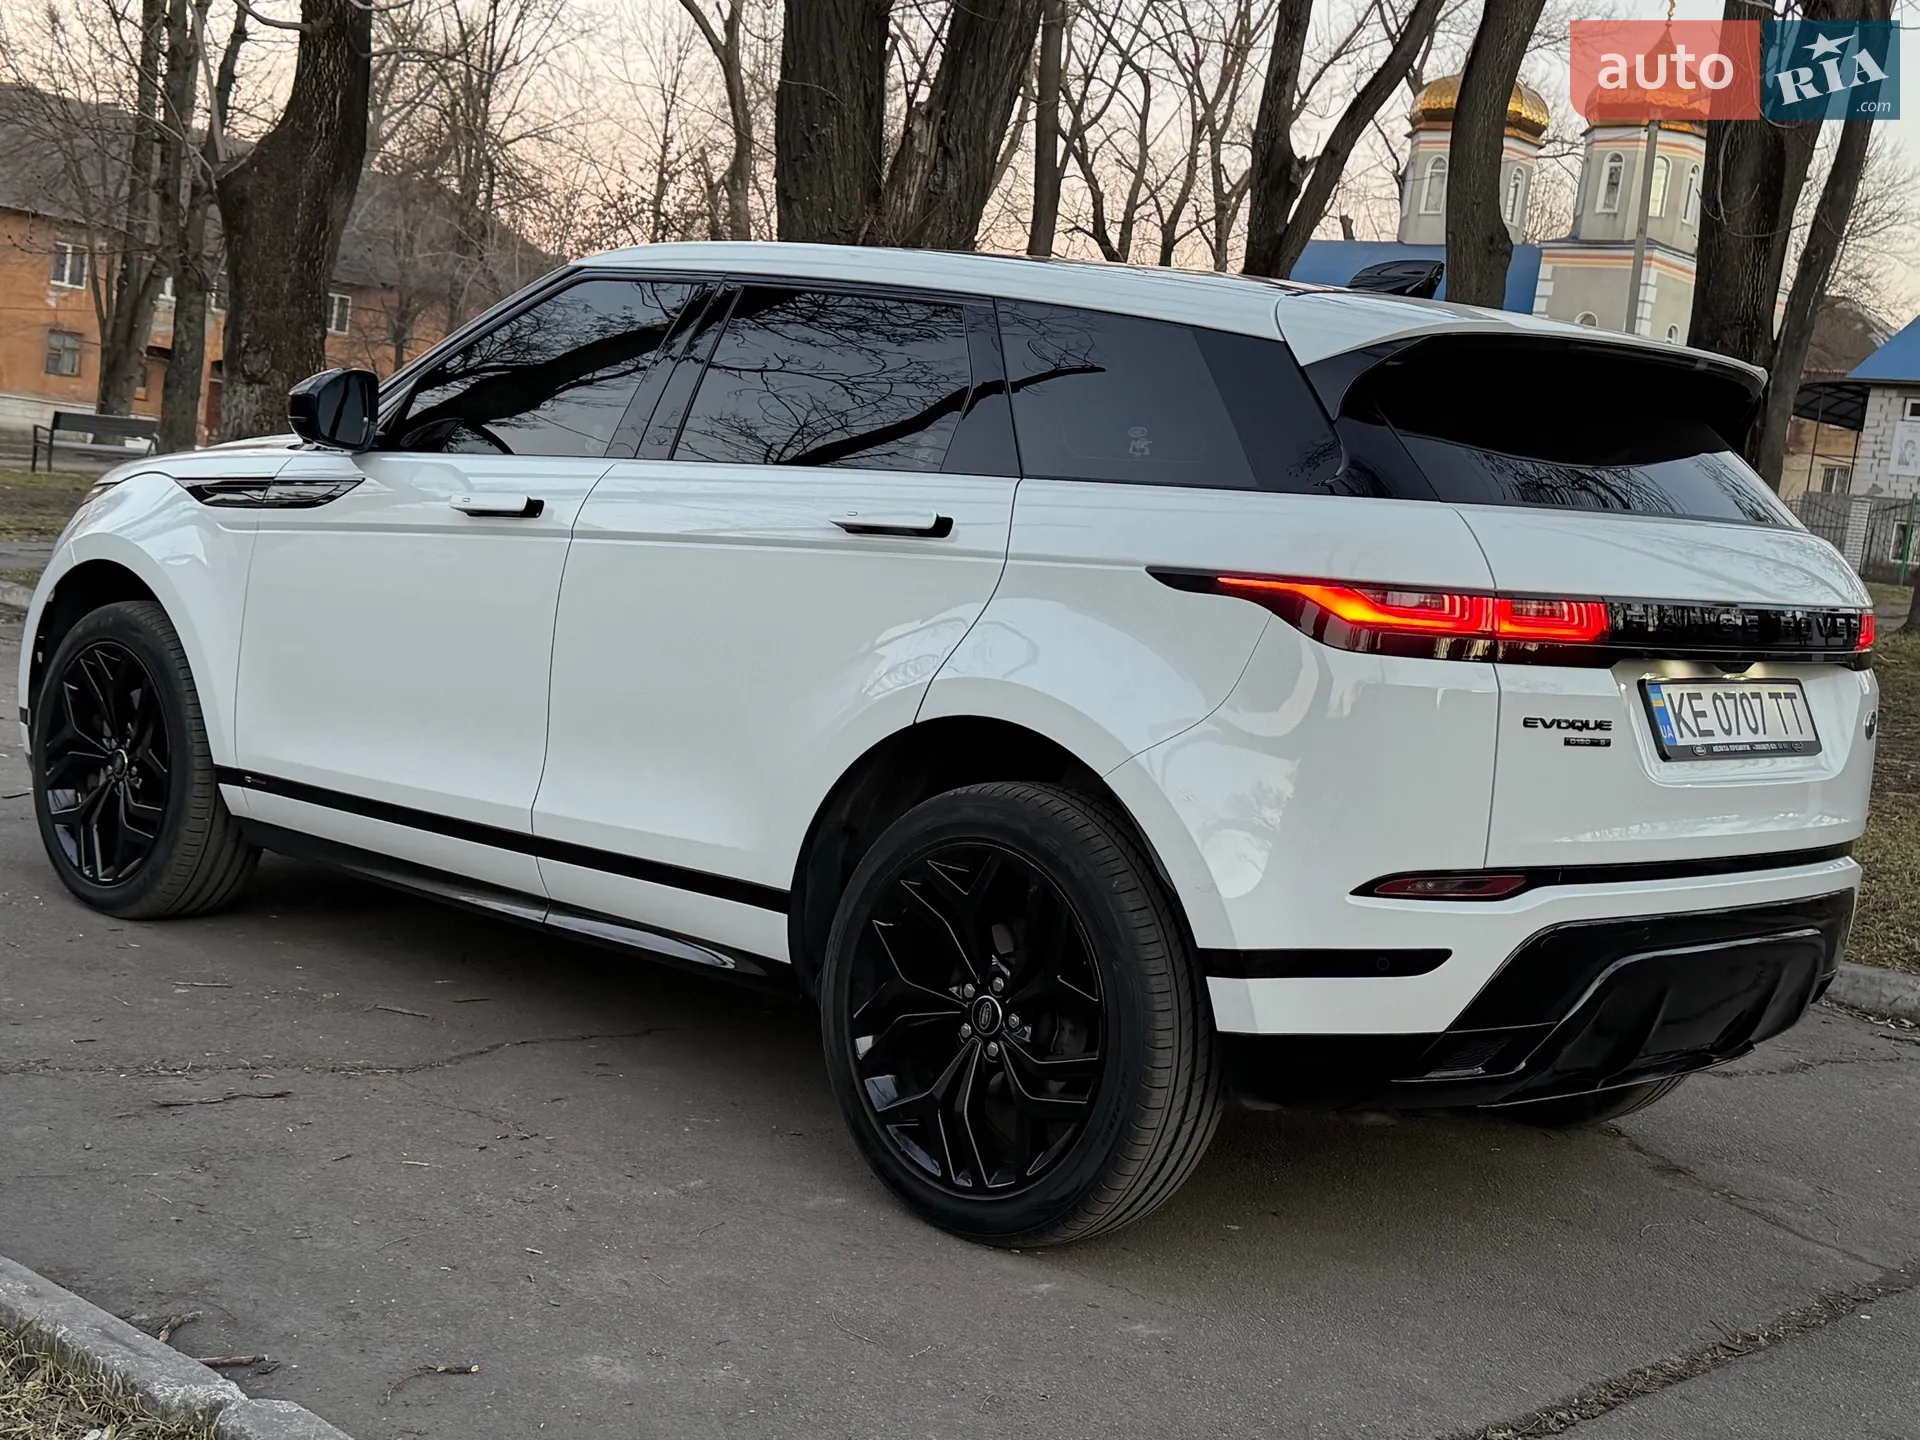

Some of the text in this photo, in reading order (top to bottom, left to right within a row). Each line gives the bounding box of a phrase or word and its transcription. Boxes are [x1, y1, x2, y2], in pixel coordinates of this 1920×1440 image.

[1667, 691, 1804, 739] KE 0707 TT
[1523, 717, 1613, 733] EVOQUE
[1661, 724, 1675, 739] UA
